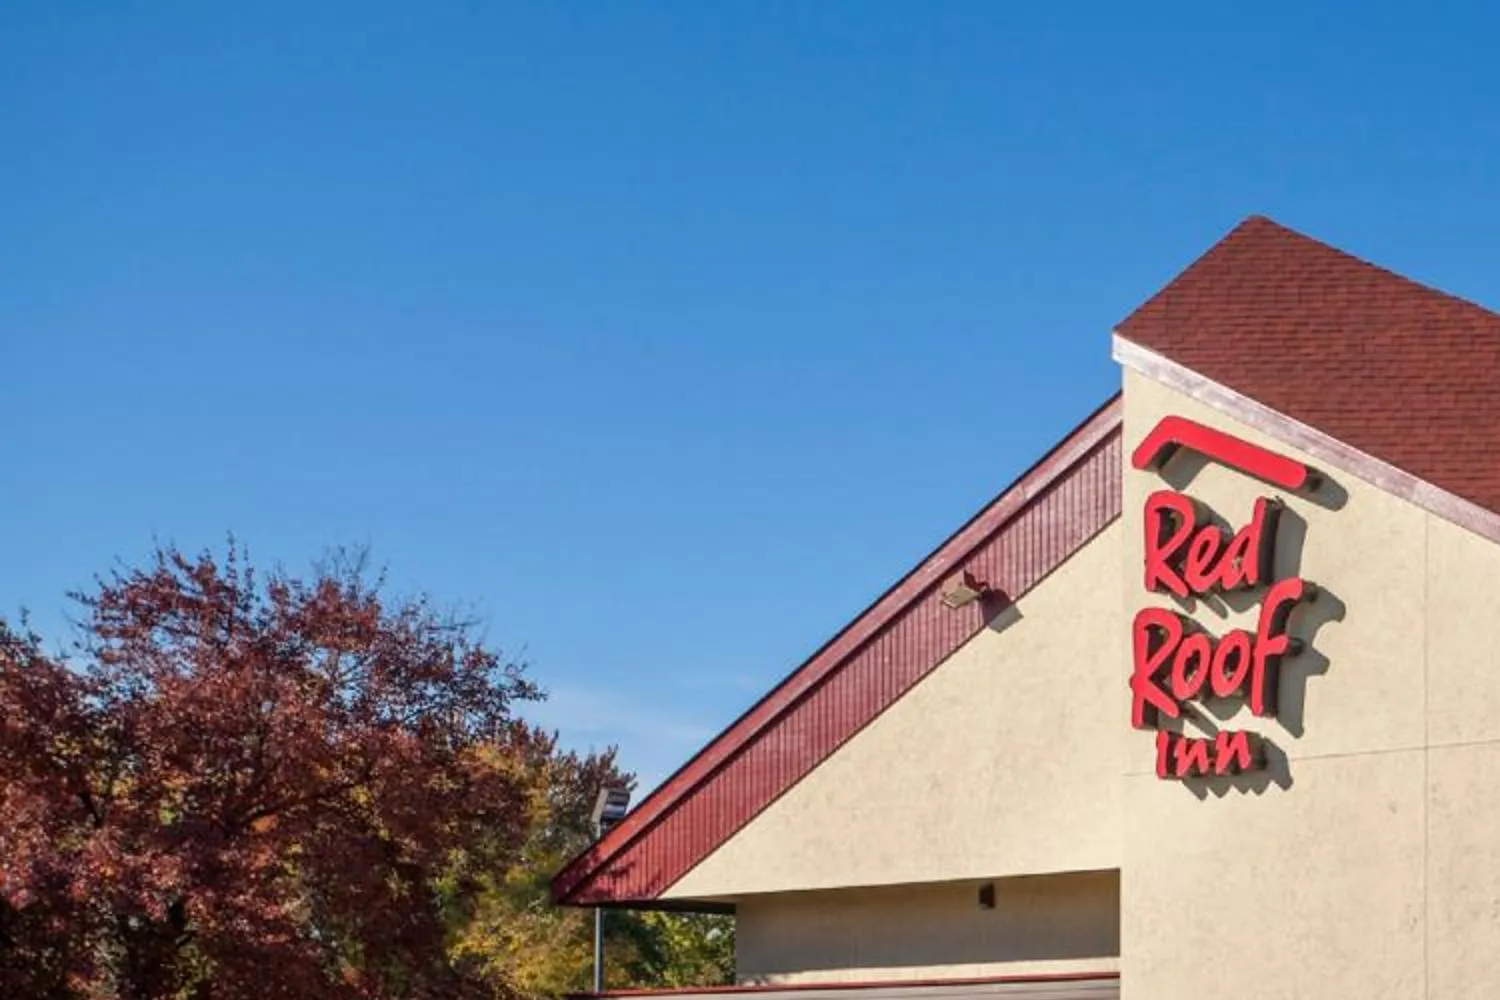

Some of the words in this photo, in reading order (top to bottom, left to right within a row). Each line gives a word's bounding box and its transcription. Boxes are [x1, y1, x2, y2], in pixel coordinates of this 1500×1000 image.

[1144, 490, 1267, 597] Red
[1129, 577, 1303, 728] Roof
[1155, 730, 1252, 779] Inn
